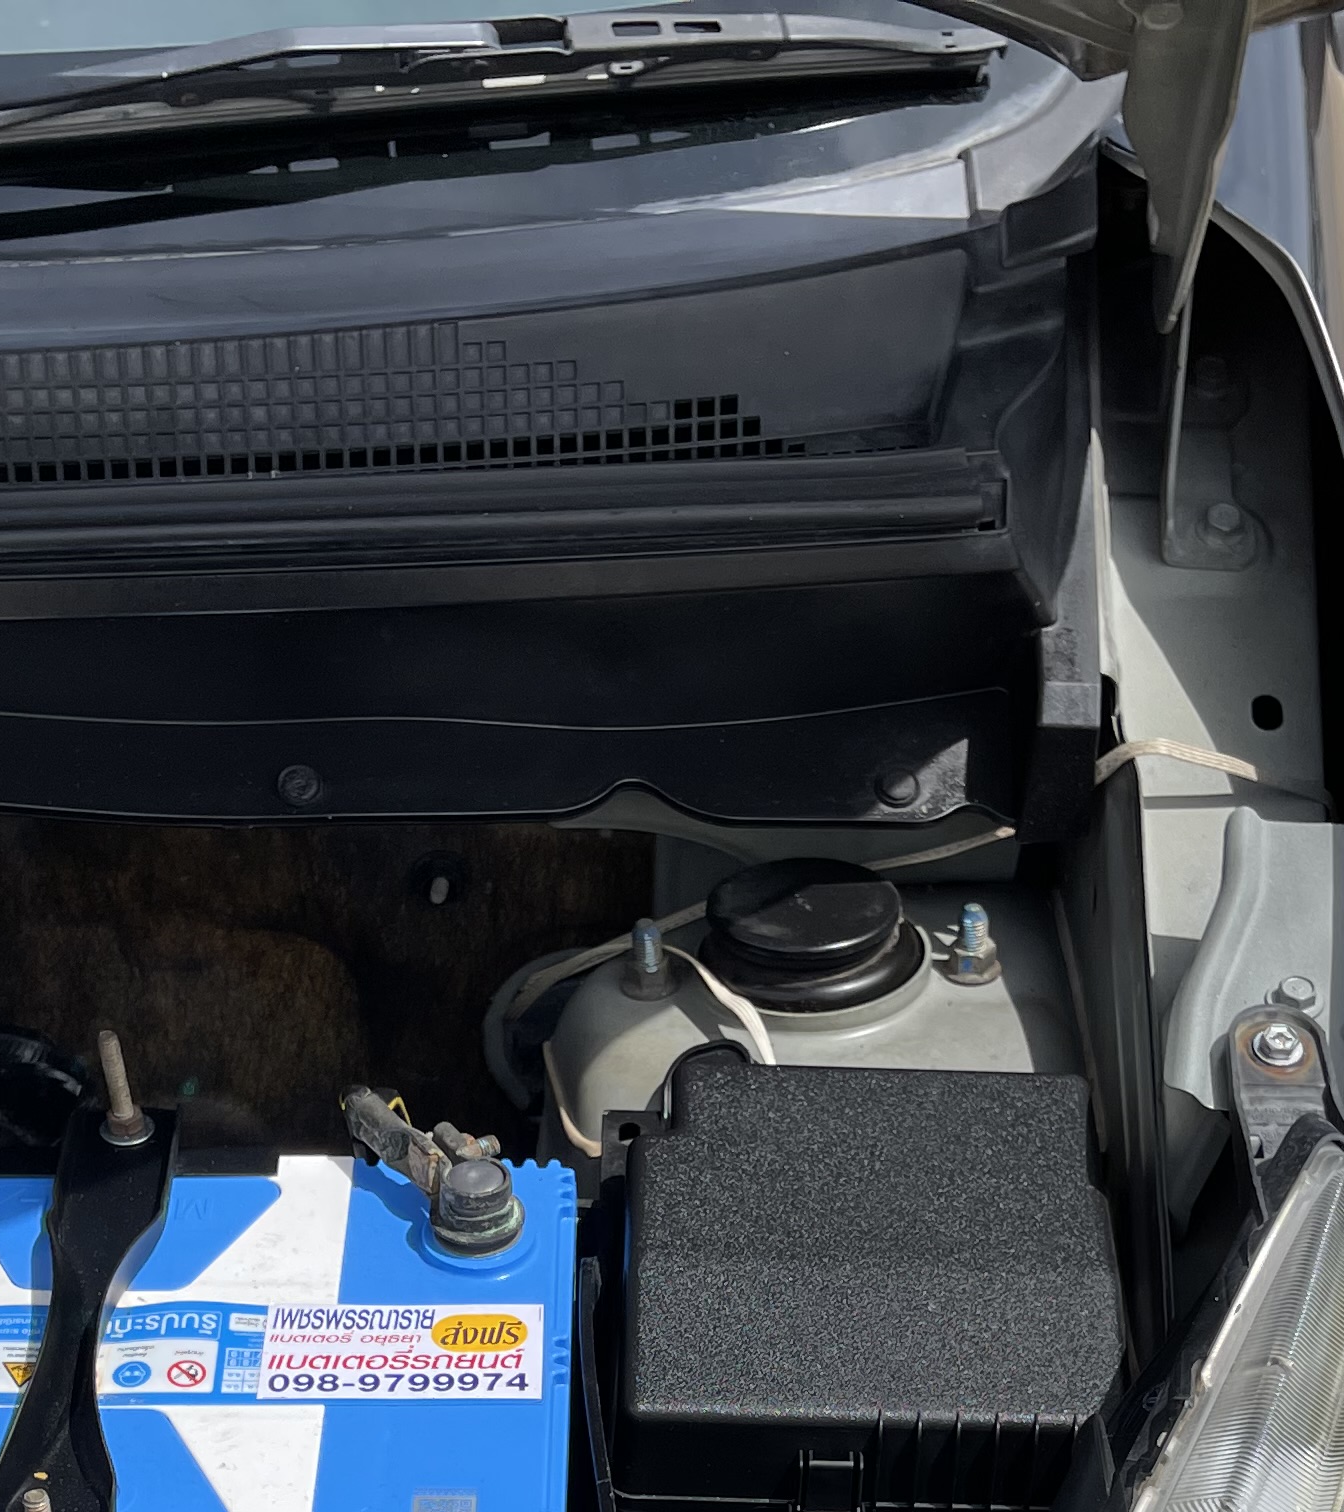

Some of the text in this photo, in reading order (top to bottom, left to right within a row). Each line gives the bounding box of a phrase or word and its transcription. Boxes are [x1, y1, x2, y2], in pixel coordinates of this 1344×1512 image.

[440, 1320, 523, 1346] ส่งฟรี
[267, 1345, 525, 1370] แบตเตอรี่รถยนต์
[268, 1373, 529, 1392] 098-9799974
